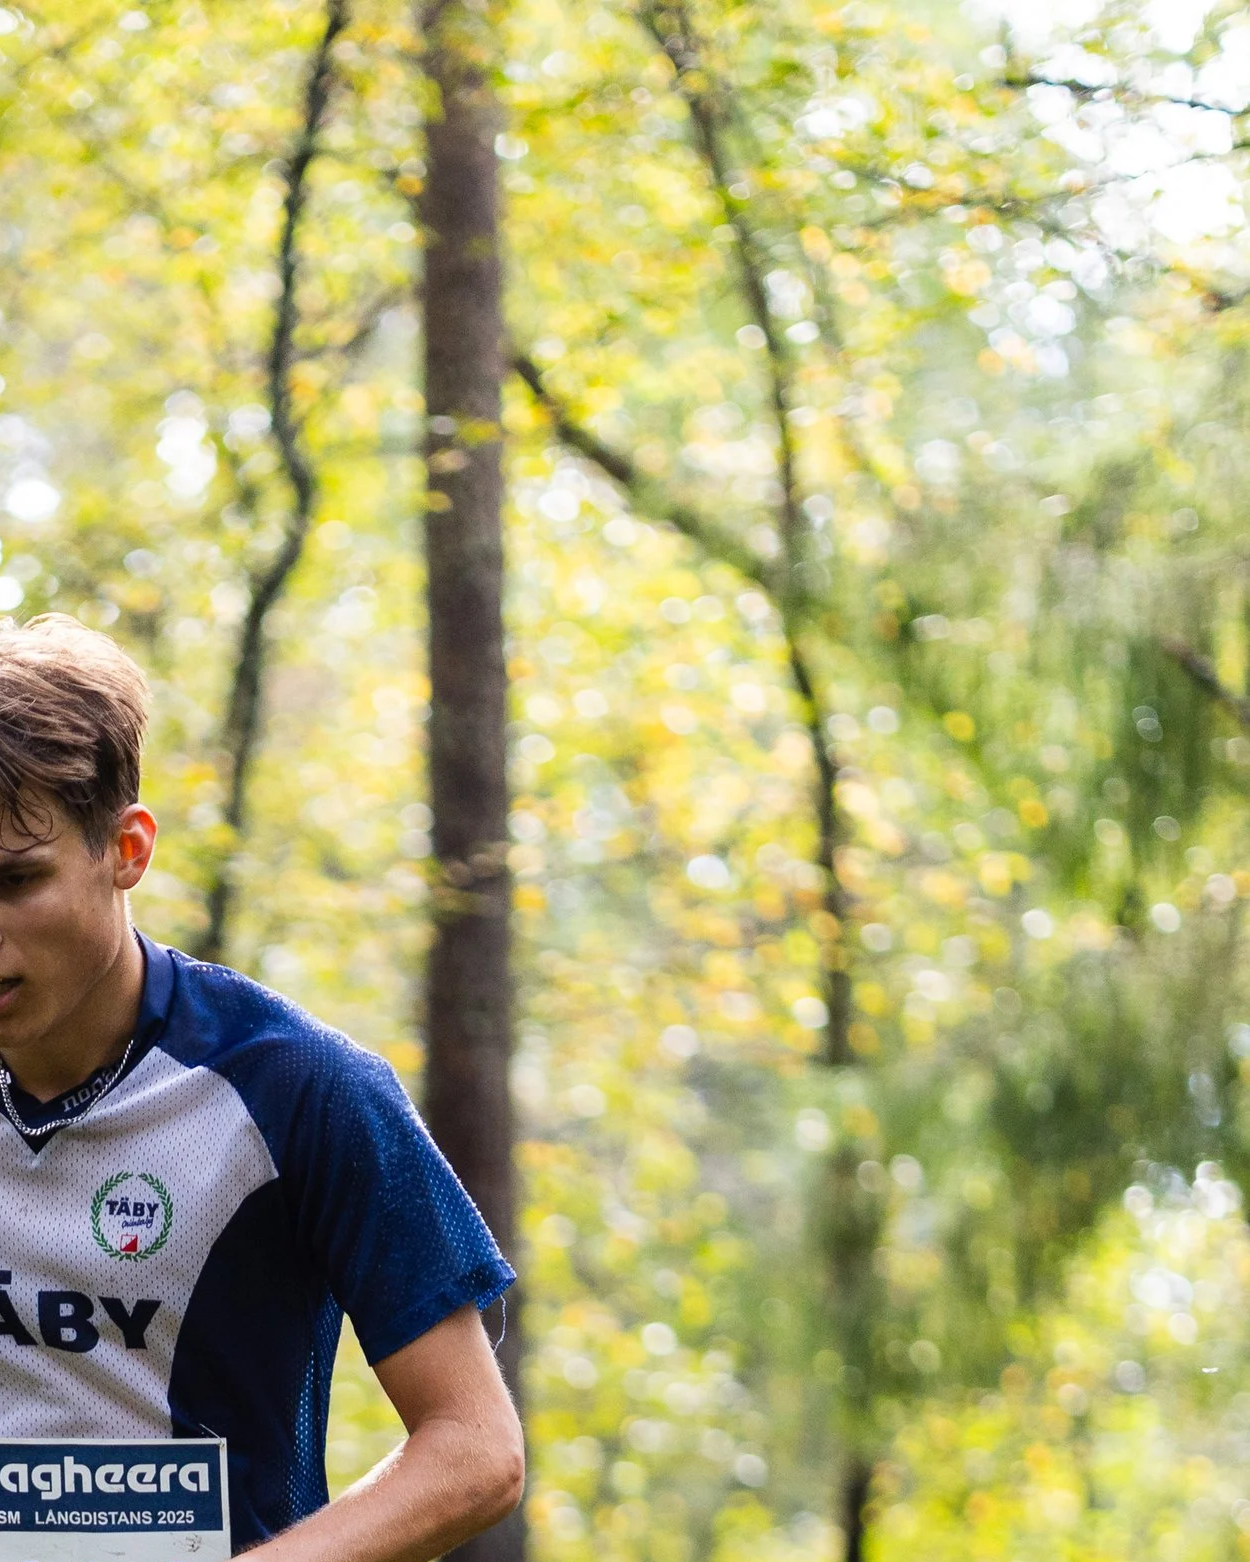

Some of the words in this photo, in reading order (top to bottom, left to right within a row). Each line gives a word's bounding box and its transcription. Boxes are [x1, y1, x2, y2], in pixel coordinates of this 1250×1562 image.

[105, 1196, 160, 1218] TÄBY
[34, 1508, 153, 1526] LÅNGDISTANS
[157, 1510, 195, 1525] 2025
